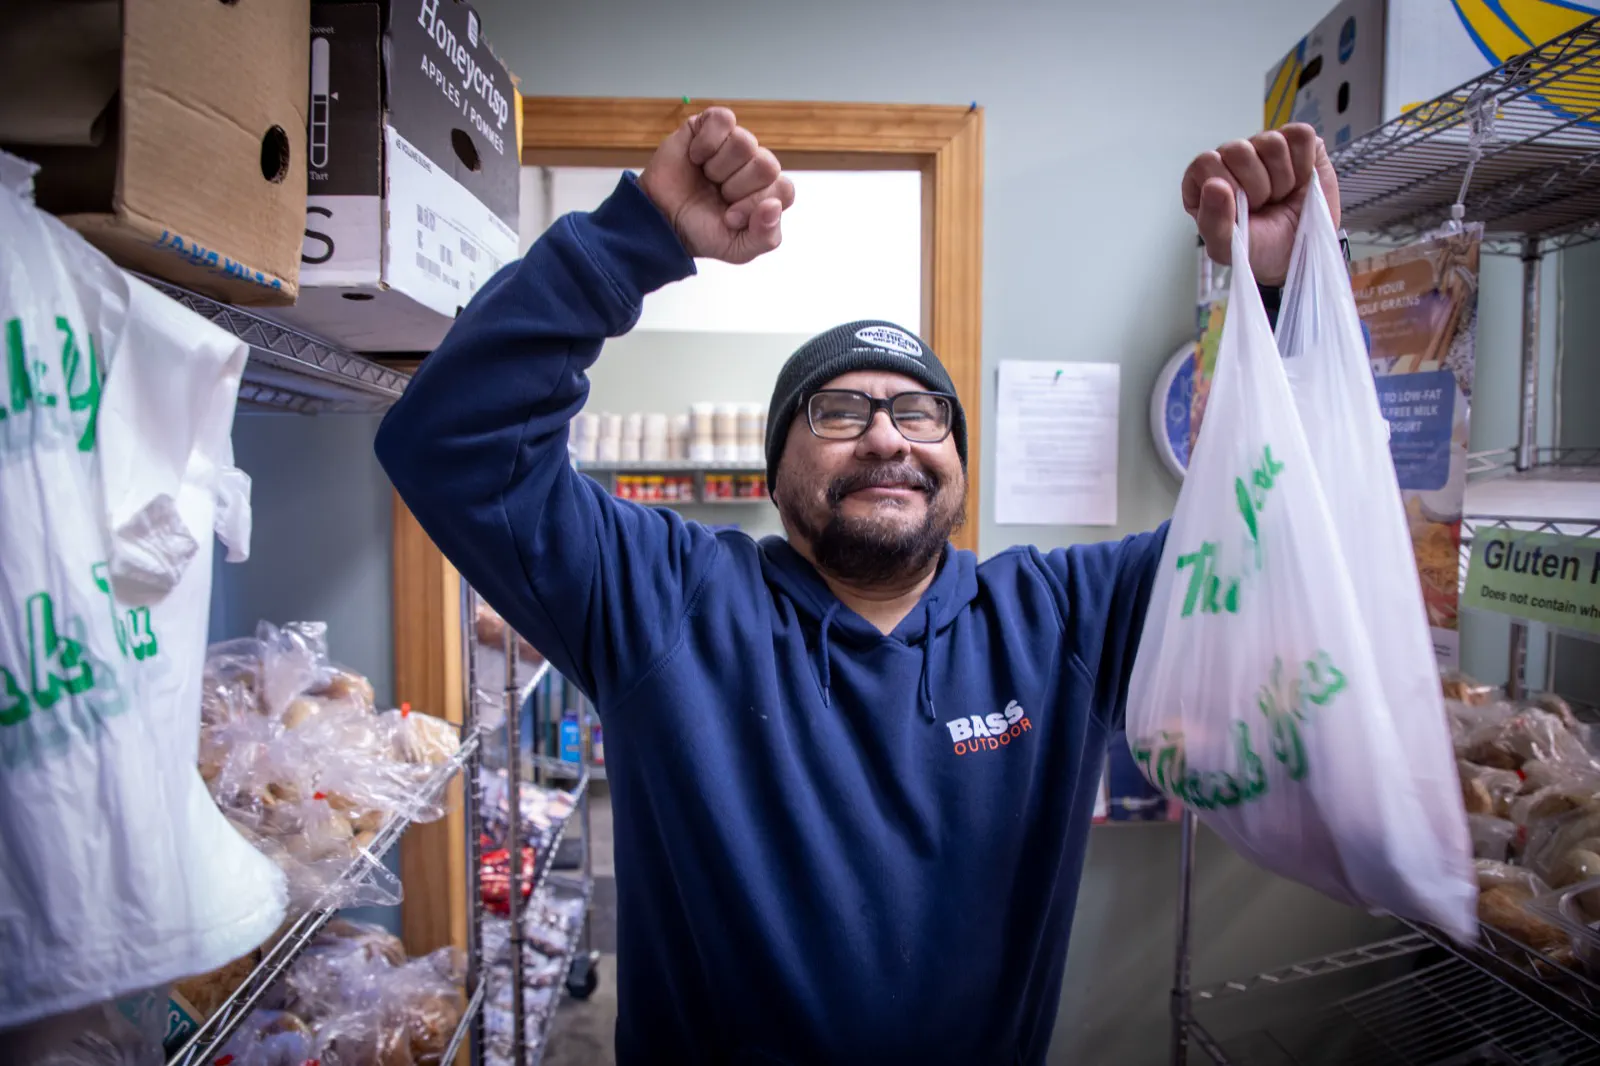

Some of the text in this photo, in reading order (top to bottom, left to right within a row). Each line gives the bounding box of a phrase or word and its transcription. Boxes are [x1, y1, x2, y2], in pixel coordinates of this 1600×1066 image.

[417, 0, 508, 130] Honeycrisp
[420, 54, 461, 109] APPLES
[470, 106, 504, 156] POMMES
[309, 171, 329, 180] Tart
[1484, 539, 1579, 582] Gluten
[1481, 584, 1508, 601] Does
[1510, 592, 1529, 605] not
[1531, 597, 1577, 614] contain
[946, 699, 1024, 743] BASS
[954, 717, 1032, 756] OUTDOOR
